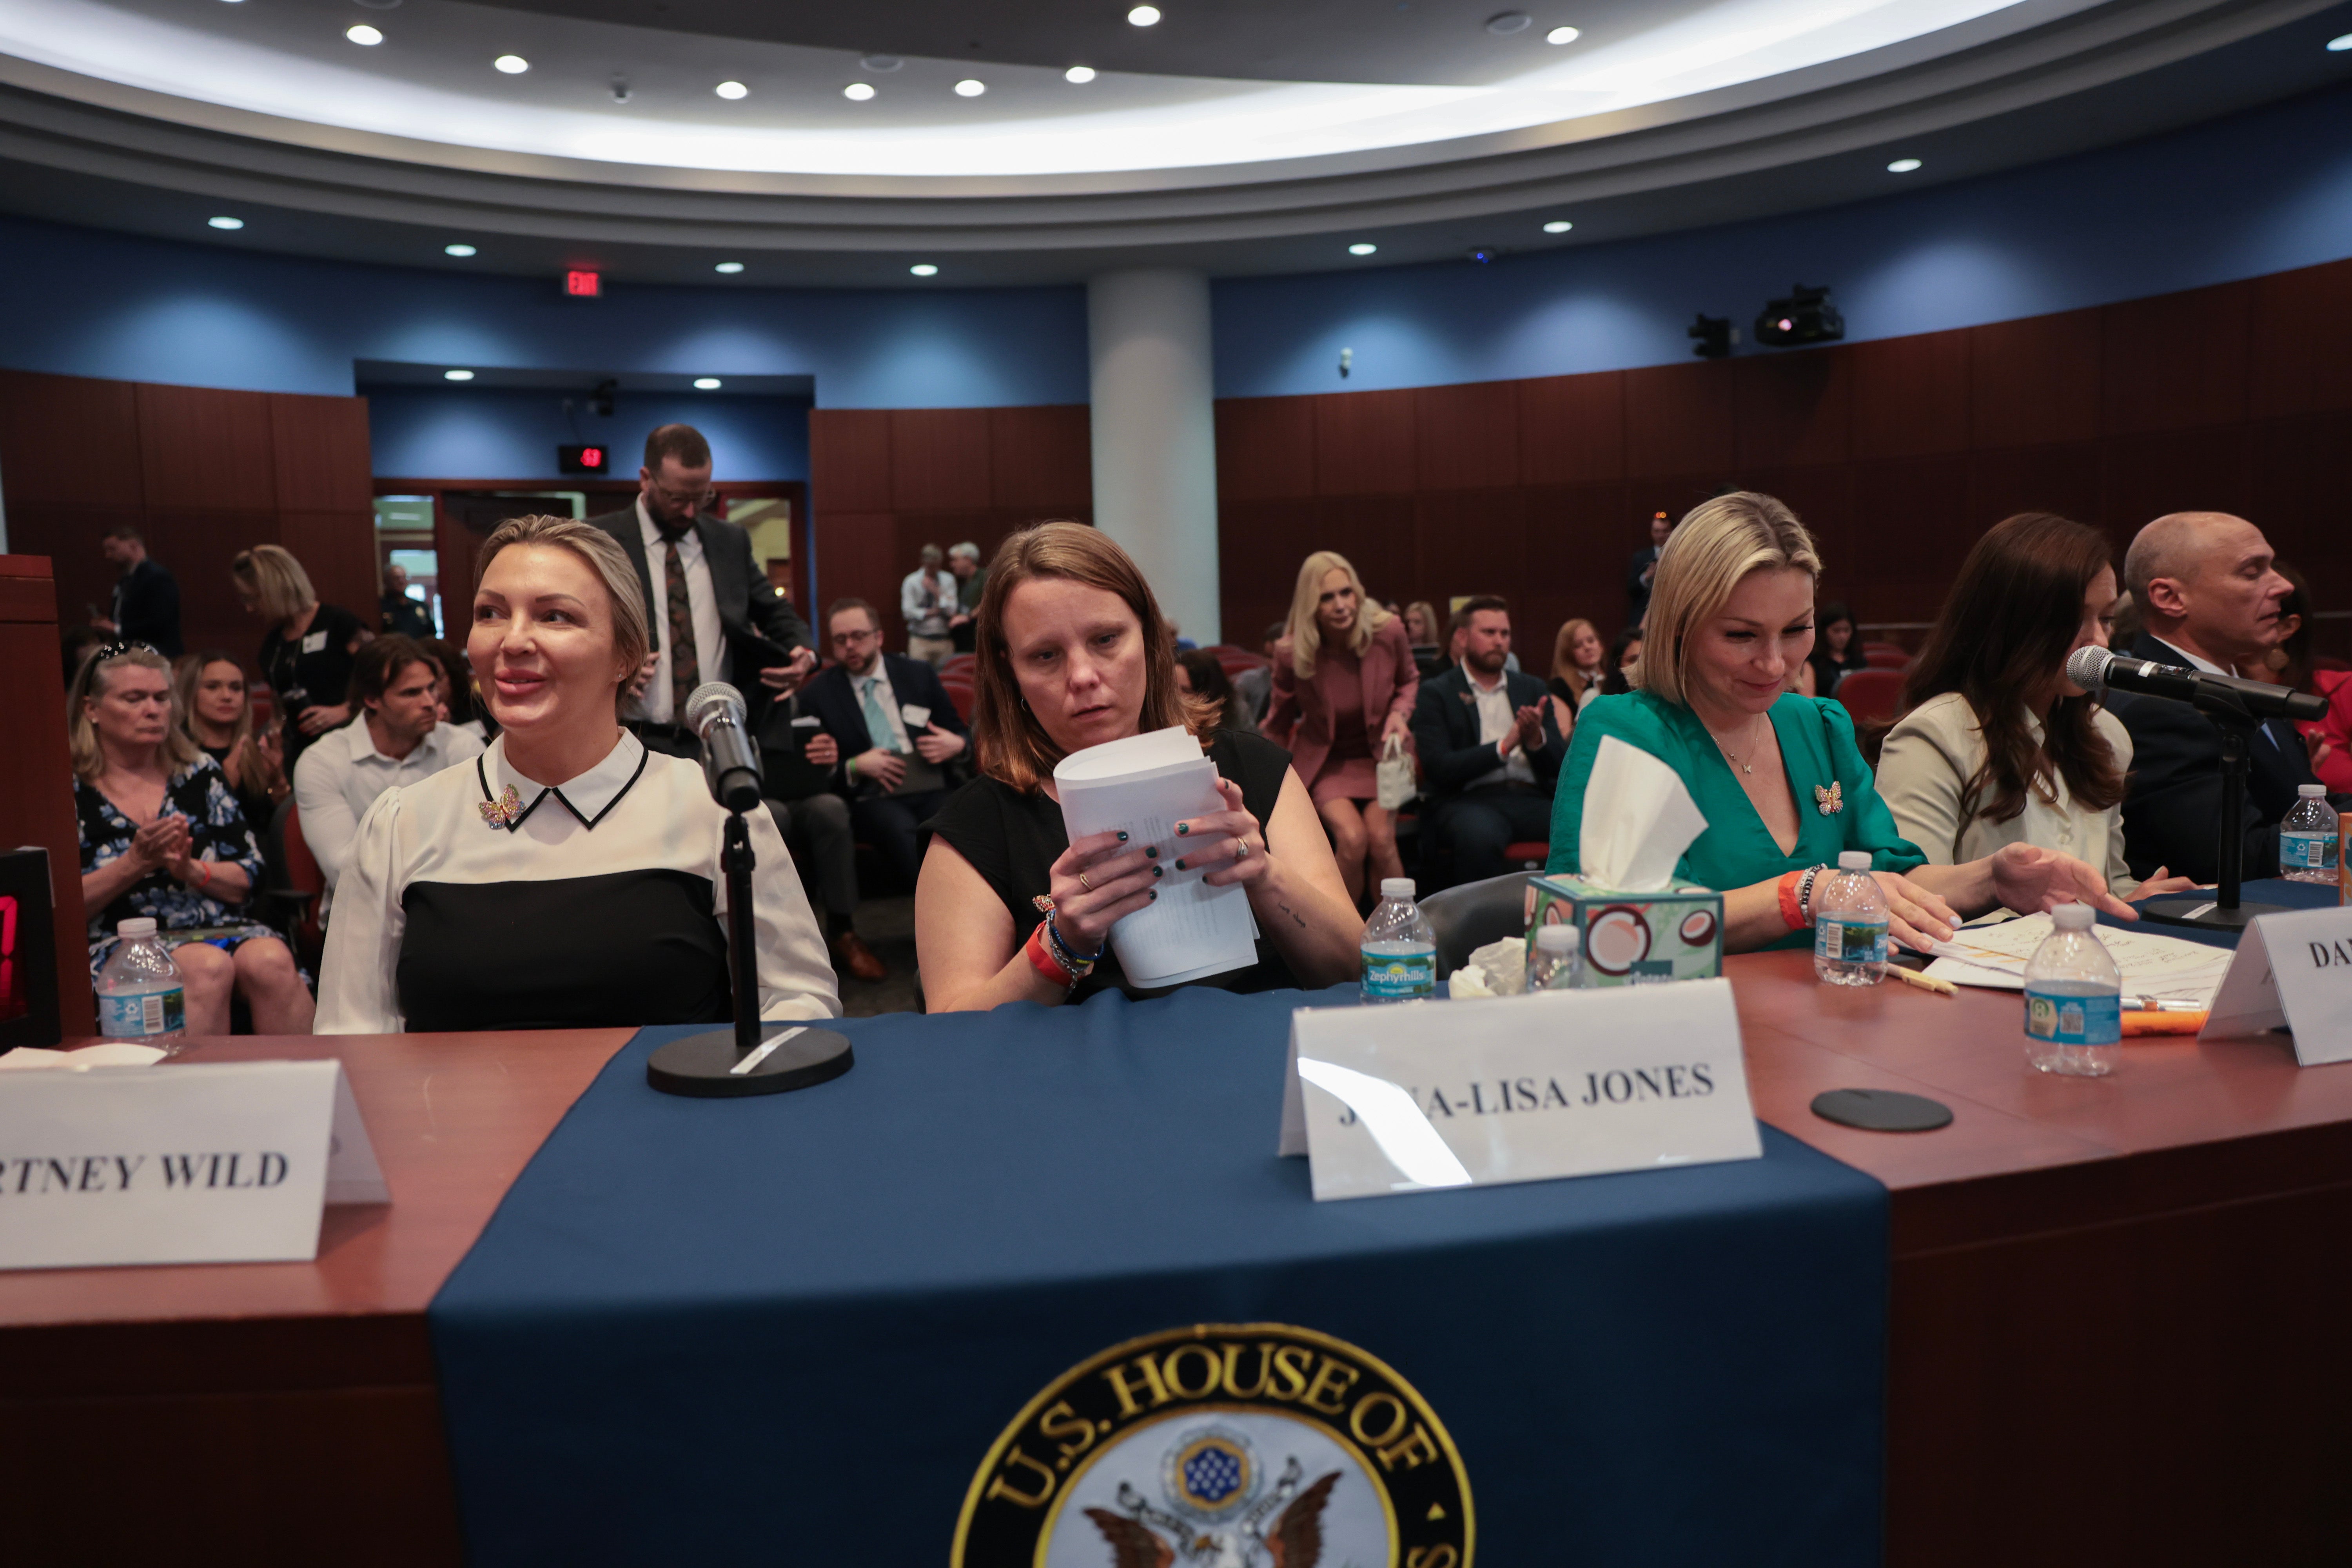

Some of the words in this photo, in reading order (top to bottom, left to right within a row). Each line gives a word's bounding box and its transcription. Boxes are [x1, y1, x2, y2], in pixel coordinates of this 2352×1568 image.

[1370, 969, 1425, 984] Zephyrhills
[1339, 1076, 1572, 1127] JA-LISA
[1581, 1062, 1715, 1106] JONES
[160, 1151, 289, 1189] WILD
[986, 1400, 1112, 1510] U.S.
[1100, 1342, 1361, 1419] HOUSE
[1349, 1390, 1440, 1472] OF
